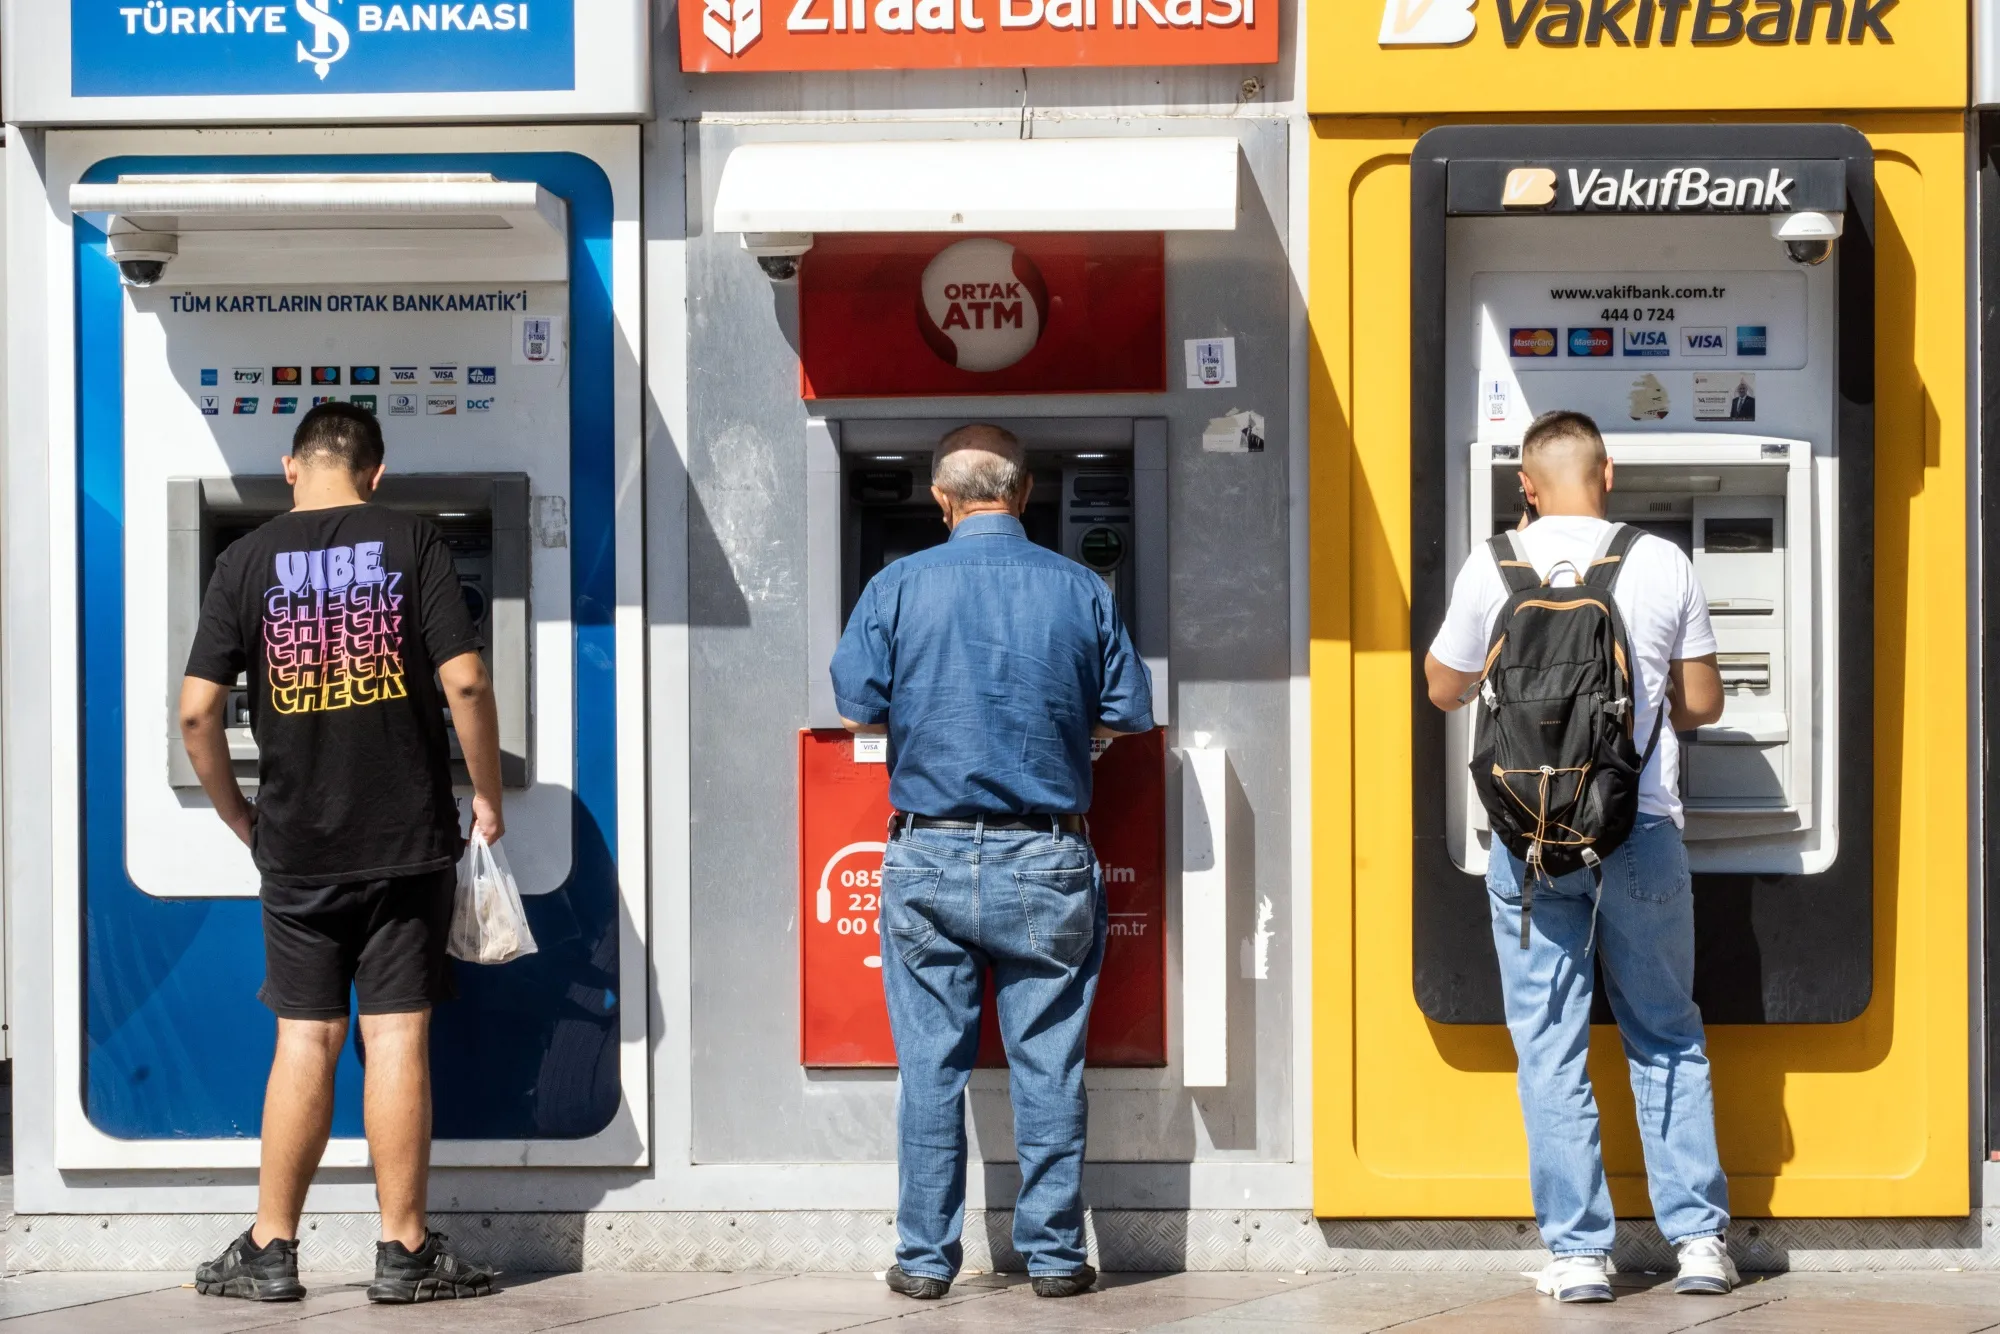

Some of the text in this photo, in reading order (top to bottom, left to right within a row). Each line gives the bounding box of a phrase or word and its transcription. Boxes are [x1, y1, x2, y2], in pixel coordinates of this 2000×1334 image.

[119, 0, 287, 35] TÜRKİYE
[358, 3, 528, 32] BANKASI
[1567, 167, 1794, 207] VakıfBank
[943, 282, 1021, 301] ORTAK
[1550, 285, 1726, 300] www.vakifbank.com.tr
[169, 291, 211, 313] TÜM
[215, 295, 322, 313] KARTLARIN
[327, 294, 389, 312] ORTAK
[941, 301, 1023, 330] ATM
[1600, 308, 1675, 321] 444 0 724
[1513, 338, 1554, 348] MasterCard
[1573, 337, 1609, 347] Maestro
[1628, 331, 1668, 346] VISA
[1687, 334, 1723, 349] VISA
[234, 370, 262, 384] troy
[394, 371, 415, 380] VISA
[434, 370, 454, 379] VISA
[475, 375, 495, 383] PLUS
[205, 398, 214, 408] V
[466, 399, 490, 409] DCC
[263, 572, 402, 624] CHECK
[272, 662, 408, 714] CHECK
[1101, 863, 1136, 883] im
[848, 893, 882, 911] 22
[837, 917, 867, 935] 00
